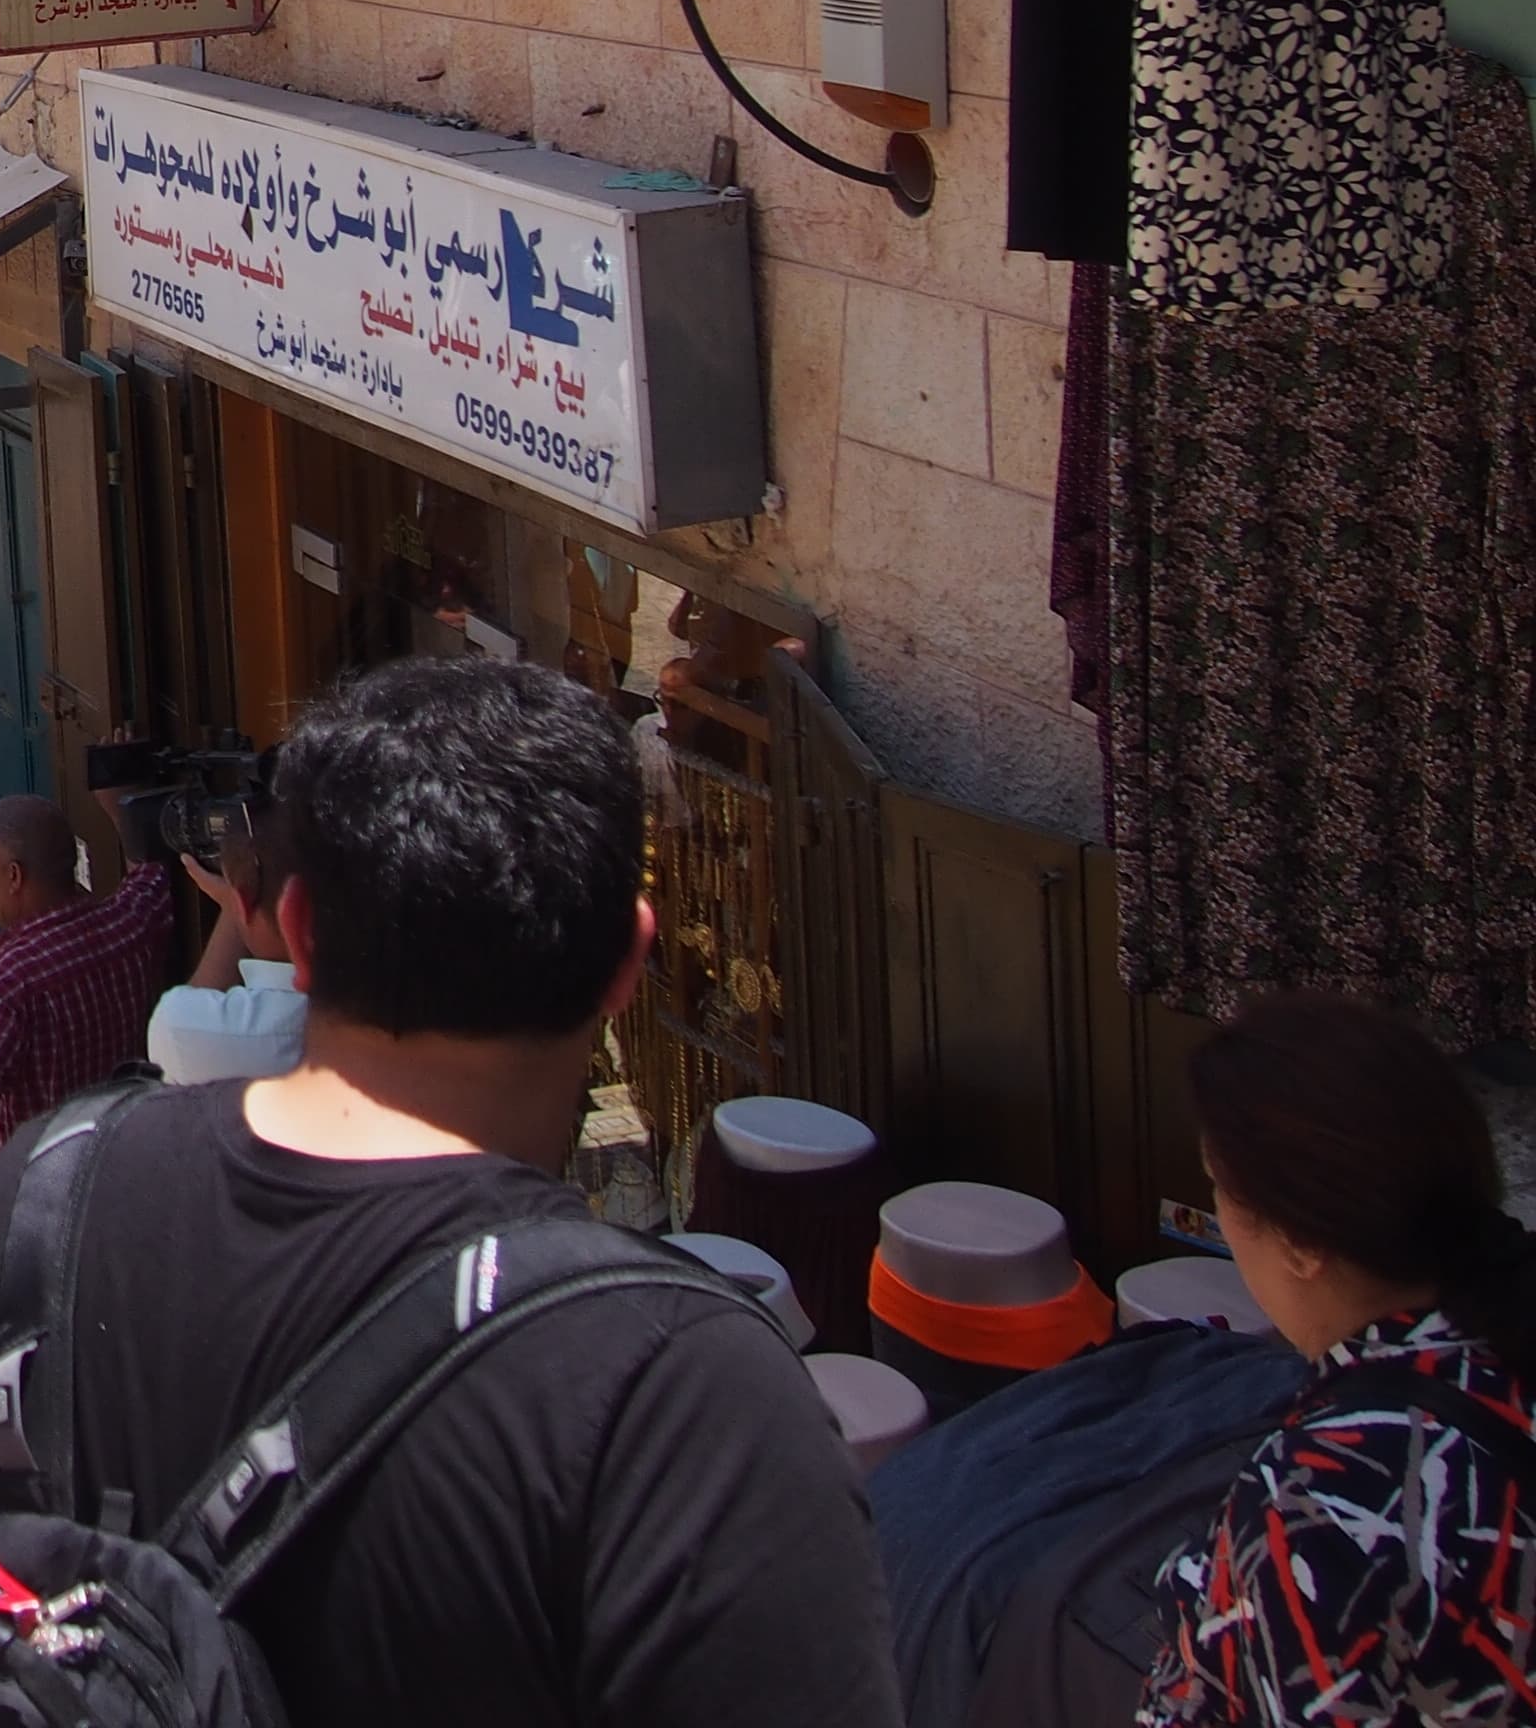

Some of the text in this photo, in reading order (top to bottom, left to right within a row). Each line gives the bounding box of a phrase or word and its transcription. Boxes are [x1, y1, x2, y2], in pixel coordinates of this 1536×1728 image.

[93, 105, 214, 202] للمجوهرات
[221, 143, 299, 240] وأولاده
[303, 162, 376, 253] شرخ
[186, 231, 233, 277] محلي
[380, 176, 416, 279] أبو
[131, 269, 205, 323] 2776565
[237, 245, 284, 290] ذهب
[425, 231, 503, 301] رسمي
[256, 309, 287, 359] شرخ
[290, 320, 306, 373] أبو
[310, 336, 347, 379] منجد
[360, 288, 586, 419] بيع شراء تبديل تصليح
[455, 392, 615, 489] 0599-939387
